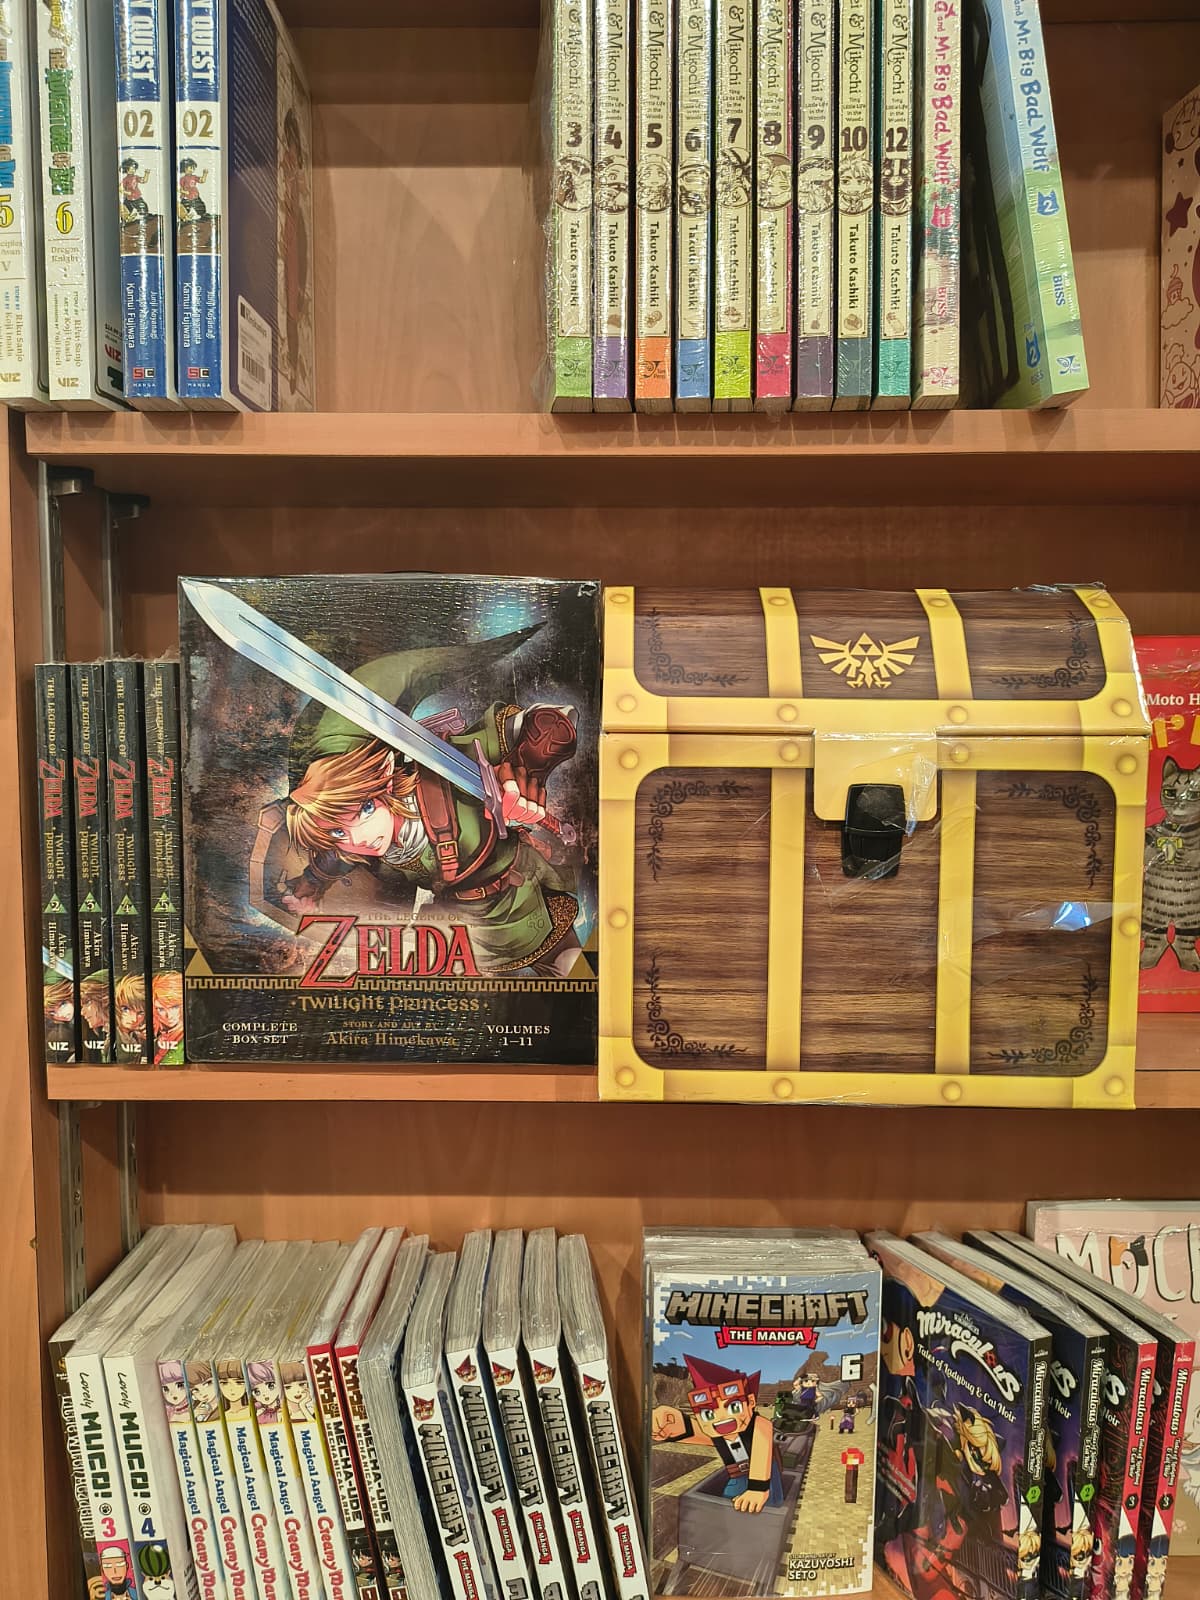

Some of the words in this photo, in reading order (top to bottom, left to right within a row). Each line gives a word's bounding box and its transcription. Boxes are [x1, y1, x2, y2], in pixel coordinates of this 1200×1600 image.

[936, 16, 947, 32] and
[1014, 19, 1029, 46] Mr.
[130, 16, 155, 83] QUEST
[191, 16, 216, 84] QUEST
[607, 32, 623, 92] Mikochi
[648, 30, 665, 91] Mikochi
[722, 25, 744, 86] Mikochi
[844, 33, 865, 94] Mikochi
[887, 34, 908, 94] Mikochi
[934, 35, 950, 61] Mr.
[1018, 48, 1035, 77] Big
[934, 64, 950, 92] Big
[931, 95, 953, 138] Bad
[1020, 79, 1043, 127] Bad
[124, 110, 154, 137] 02
[183, 110, 213, 137] 02
[566, 121, 582, 147] 3
[604, 124, 622, 149] 4
[646, 123, 662, 149] 5
[685, 128, 701, 152] 6
[727, 118, 742, 144] 7
[762, 121, 782, 147] 8
[807, 124, 825, 150] 9
[840, 126, 868, 152] 10
[884, 126, 908, 152] 12
[933, 139, 954, 185] Wolf
[1027, 125, 1049, 173] Wolf
[56, 202, 74, 234] 6
[1043, 199, 1056, 213] 2
[608, 221, 619, 262] Takuto
[649, 221, 660, 262] Takuto
[729, 215, 740, 256] Takuto
[848, 224, 859, 264] Takuto
[891, 224, 902, 264] Takuto
[126, 282, 136, 309] Kamui
[182, 282, 192, 309] Kamui
[608, 265, 619, 307] Kashiki
[649, 265, 660, 307] Kashiki
[729, 259, 740, 302] Kashiki
[848, 267, 859, 309] Kashiki
[891, 267, 902, 310] Kashiki
[126, 313, 137, 348] Fujiwara
[181, 312, 192, 348] Fujiwara
[47, 678, 56, 698] THE
[1146, 693, 1184, 706] Moto
[48, 702, 57, 741] LEGEND
[49, 743, 57, 756] OF
[39, 759, 66, 820] ZELDA
[73, 757, 100, 817] ZELDA
[109, 759, 135, 820] ZELDA
[148, 757, 174, 817] ZELDA
[51, 901, 60, 911] 2
[123, 902, 130, 912] 4
[160, 901, 168, 911] 5
[48, 922, 57, 969] Himekawa
[58, 932, 68, 958] Akira
[83, 921, 92, 968] Himekawa
[93, 931, 103, 957] Akira
[120, 923, 130, 971] Himekawa
[130, 934, 139, 960] Akira
[168, 931, 177, 957] Akira
[296, 914, 482, 988] ZELDA
[222, 1021, 298, 1033] COMPLETE
[232, 1034, 259, 1045] BOX
[262, 1034, 289, 1045] SET
[326, 1032, 369, 1046] Akira
[375, 1032, 459, 1047] Himekawa
[342, 1020, 374, 1029] STORY
[377, 1021, 398, 1029] AND
[487, 1024, 551, 1036] VOLUMES
[48, 1041, 69, 1051] VIZ
[84, 1040, 105, 1050] VIZ
[120, 1043, 142, 1053] VIZ
[157, 1041, 178, 1050] VIZ
[664, 1290, 869, 1328] MINECRAFT
[729, 1330, 753, 1342] THE
[757, 1330, 804, 1342] MANGA
[840, 1353, 864, 1382] 6
[916, 1310, 1021, 1402] Miraculous
[79, 1372, 92, 1408] Lovely
[117, 1372, 130, 1408] Lovely
[918, 1343, 935, 1363] Tales
[983, 1393, 998, 1409] Cat
[1136, 1368, 1151, 1435] Miraculous:
[1171, 1368, 1188, 1436] Miraculous:
[177, 1431, 192, 1478] Magical
[205, 1429, 221, 1476] Magical
[236, 1427, 251, 1474] Magical
[269, 1431, 284, 1478] Magical
[300, 1430, 316, 1476] Magical
[458, 1385, 507, 1503] MINECRAFT
[498, 1388, 543, 1507] MINECRAFT
[538, 1387, 582, 1505] MINECRAFT
[587, 1401, 630, 1521] MINECRAFT
[333, 1421, 362, 1522] MECHA-UDE
[362, 1423, 392, 1523] MECHA-UDE
[418, 1423, 470, 1547] MINECRAFT
[185, 1479, 201, 1515] Angel
[213, 1478, 229, 1514] Angel
[244, 1475, 260, 1511] Angel
[277, 1479, 293, 1515] Angel
[309, 1477, 326, 1514] Angel
[102, 1517, 116, 1538] 3
[141, 1517, 156, 1538] 4
[191, 1517, 210, 1571] Creamy
[220, 1516, 239, 1571] Creamy
[251, 1513, 270, 1567] Creamy
[284, 1518, 303, 1572] Creamy
[317, 1516, 337, 1571] Creamy
[501, 1530, 512, 1554] MANGA
[576, 1531, 586, 1555] MANGA
[788, 1557, 854, 1570] KAZUYOSHI
[788, 1570, 817, 1581] SETO
